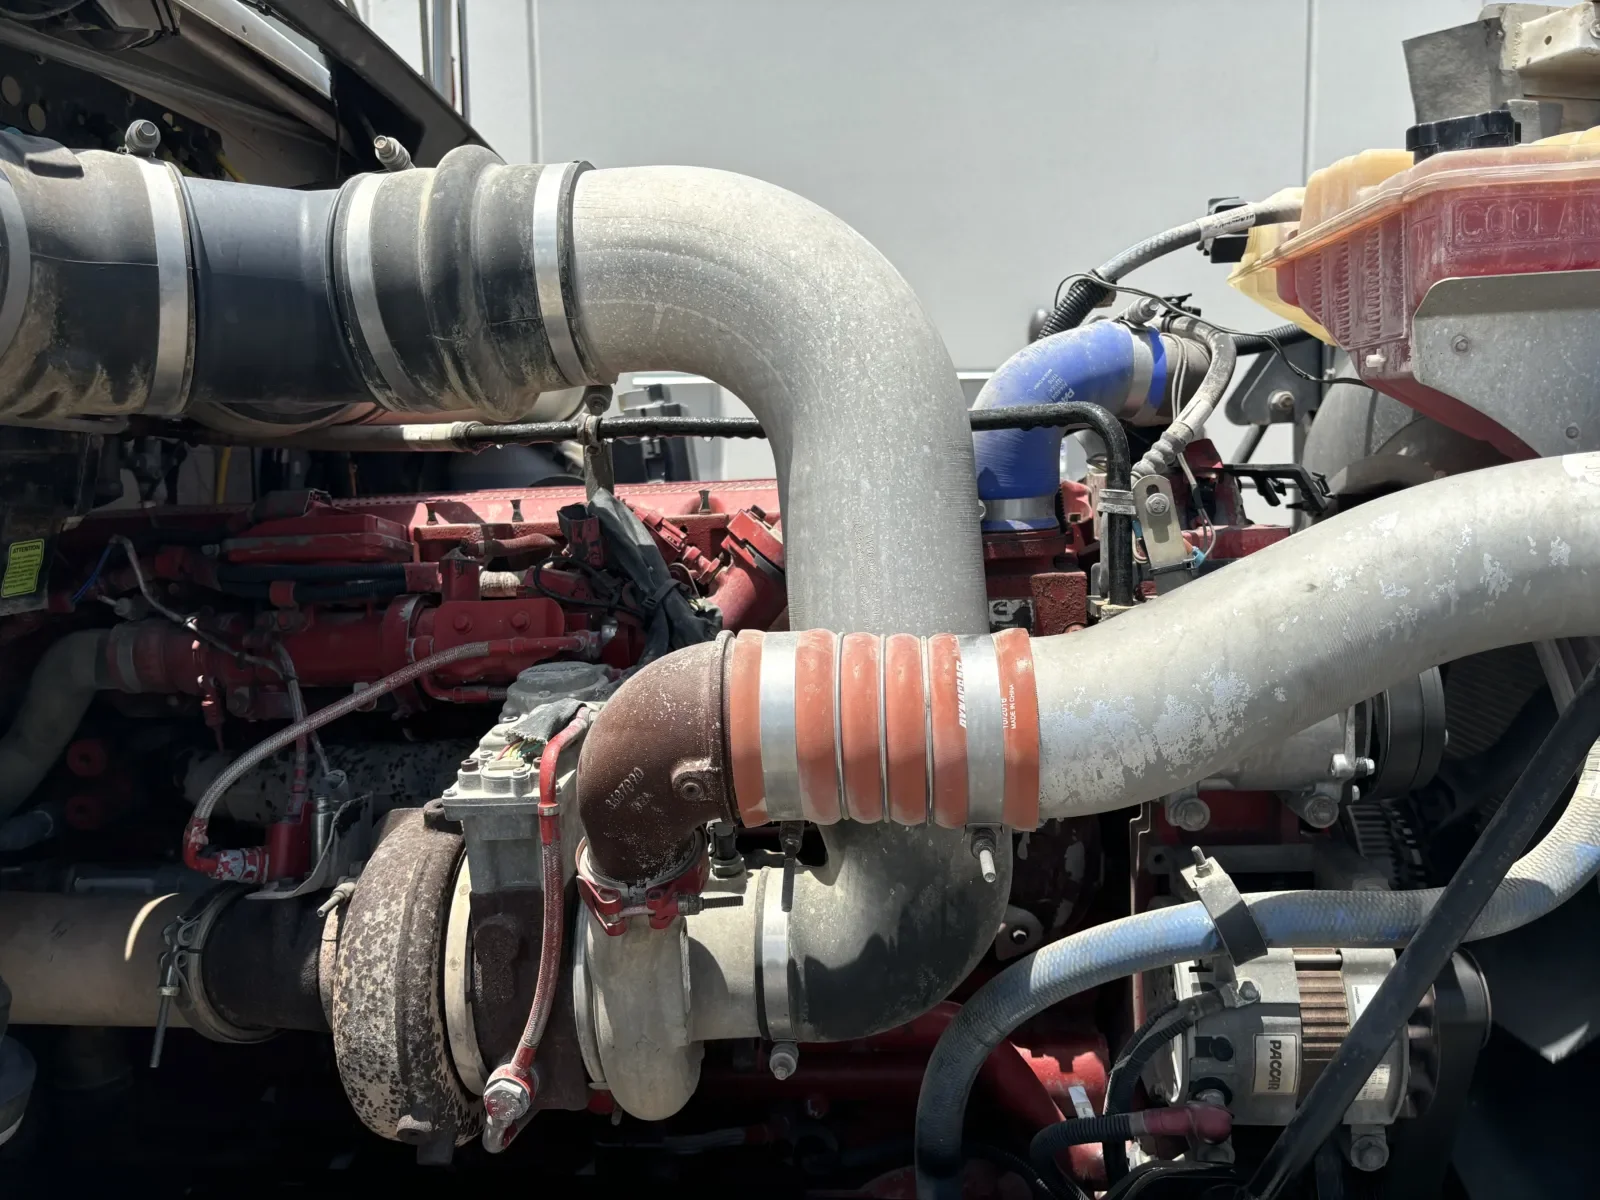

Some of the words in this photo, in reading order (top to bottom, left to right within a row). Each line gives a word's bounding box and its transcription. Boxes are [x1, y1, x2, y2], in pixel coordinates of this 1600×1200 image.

[1459, 200, 1600, 239] COOLAN
[13, 544, 40, 554] ATTENTION
[605, 767, 644, 809] 3687090
[1268, 1039, 1282, 1090] PACCAR
